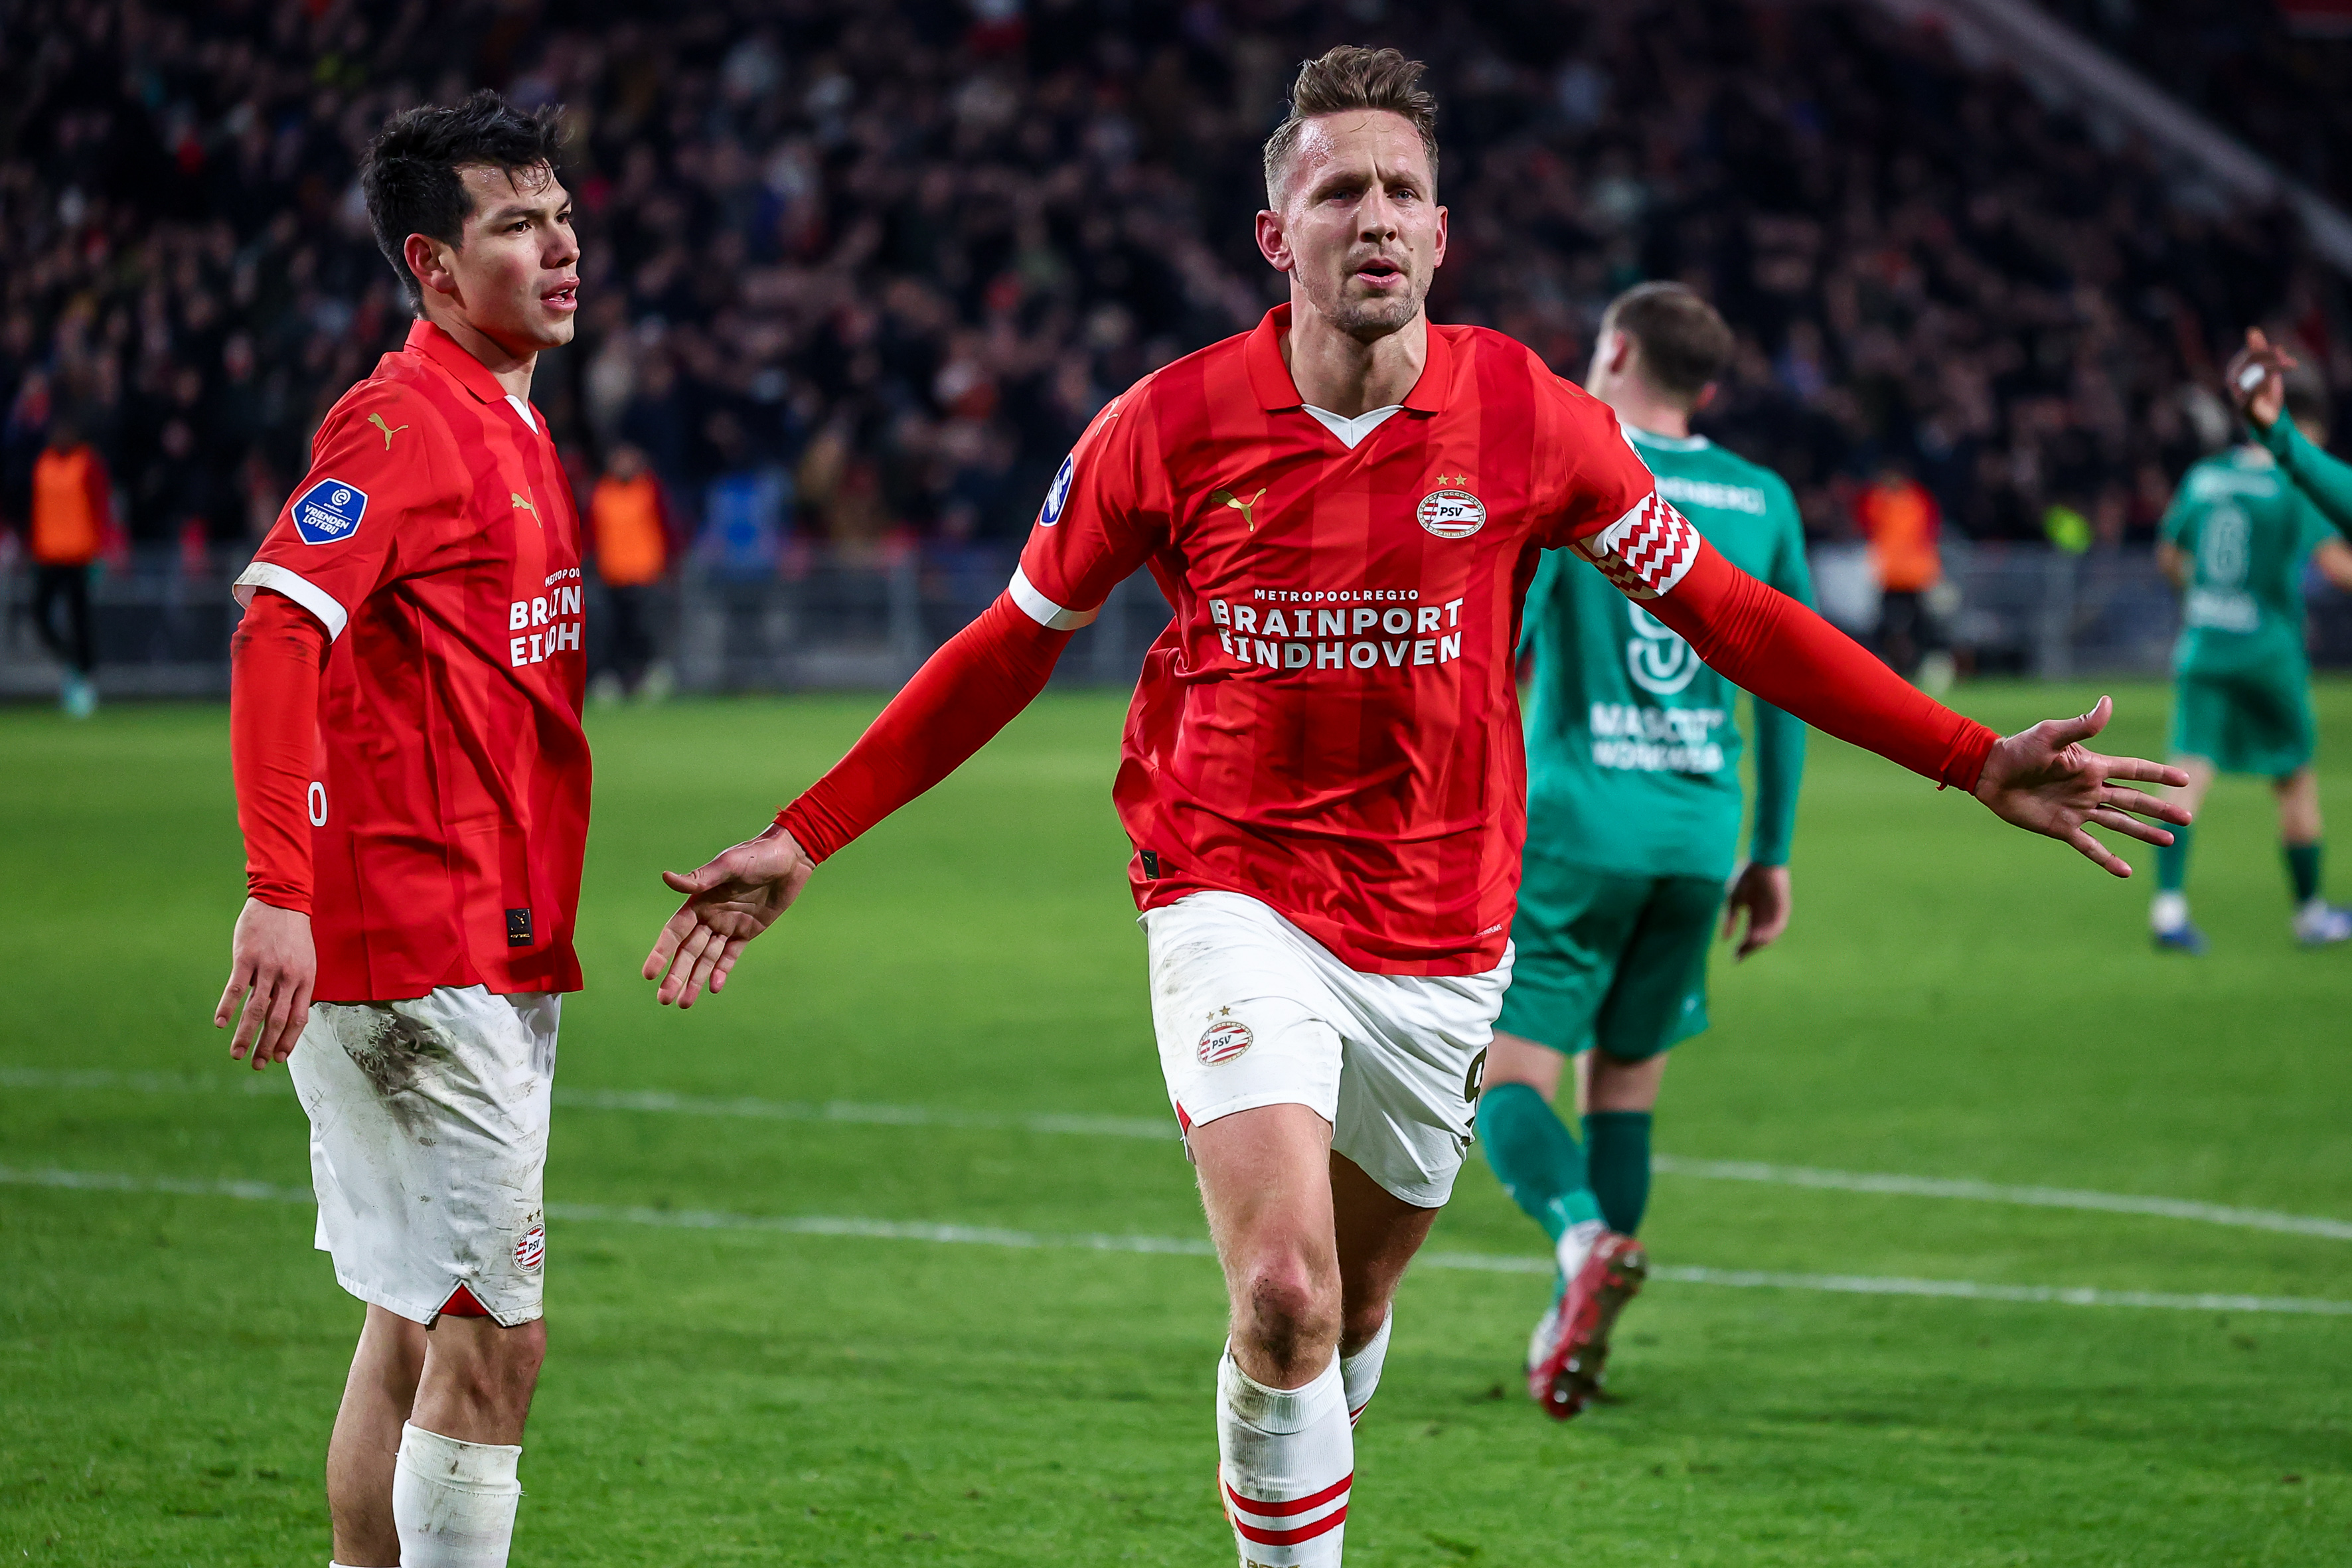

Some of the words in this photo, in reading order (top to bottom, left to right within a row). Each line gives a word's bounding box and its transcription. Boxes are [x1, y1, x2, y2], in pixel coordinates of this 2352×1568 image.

[305, 505, 350, 530] VRIENDEN
[1439, 507, 1463, 516] PSV
[303, 514, 339, 534] LOTERIJ
[1254, 589, 1419, 602] METROPOOLREGIO
[1208, 597, 1464, 638] BRAINPORT
[1217, 631, 1462, 670] EINDHOVEN
[1212, 1034, 1232, 1050] PSV
[528, 1238, 540, 1253] PSV
